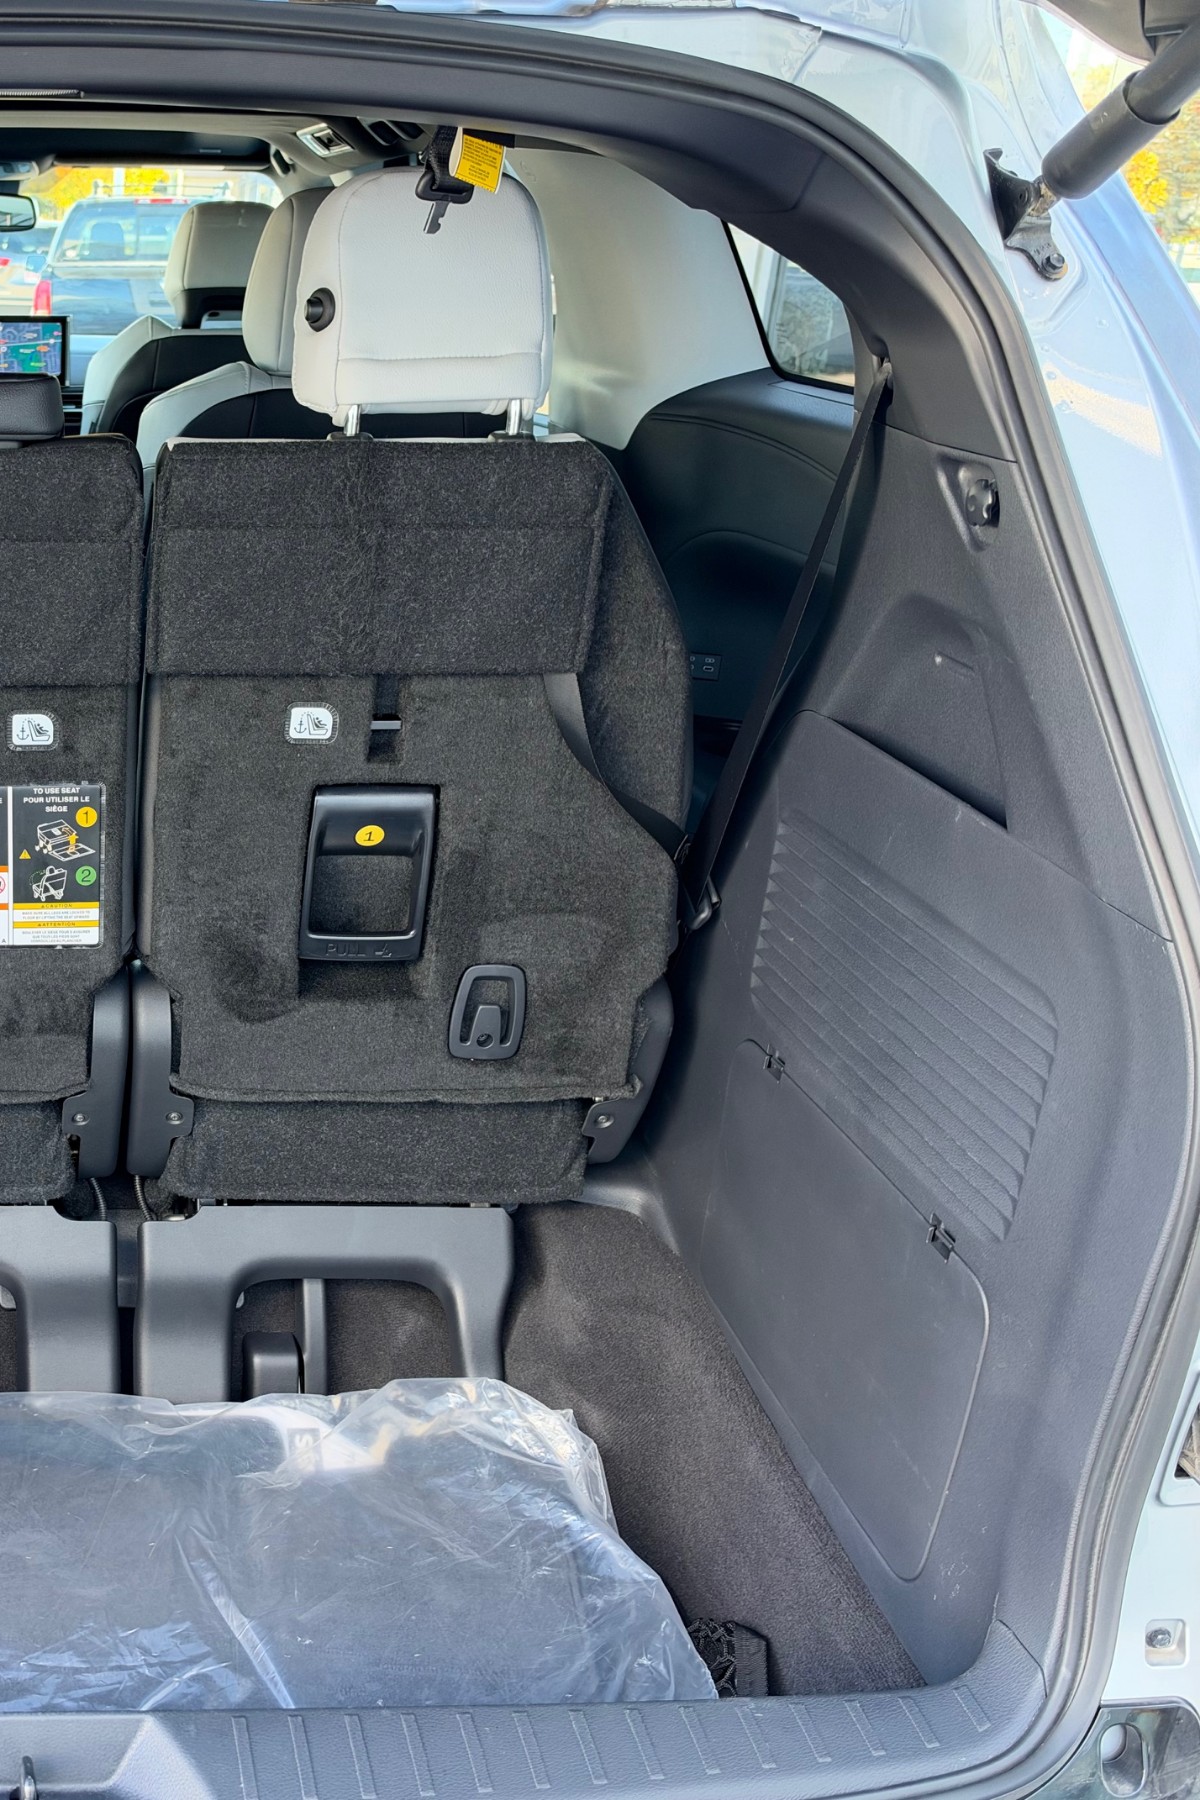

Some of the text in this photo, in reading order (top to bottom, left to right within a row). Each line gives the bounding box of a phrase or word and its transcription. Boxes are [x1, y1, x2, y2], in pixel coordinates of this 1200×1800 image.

[82, 810, 89, 824] 1
[363, 831, 375, 842] 1
[81, 868, 91, 883] 2
